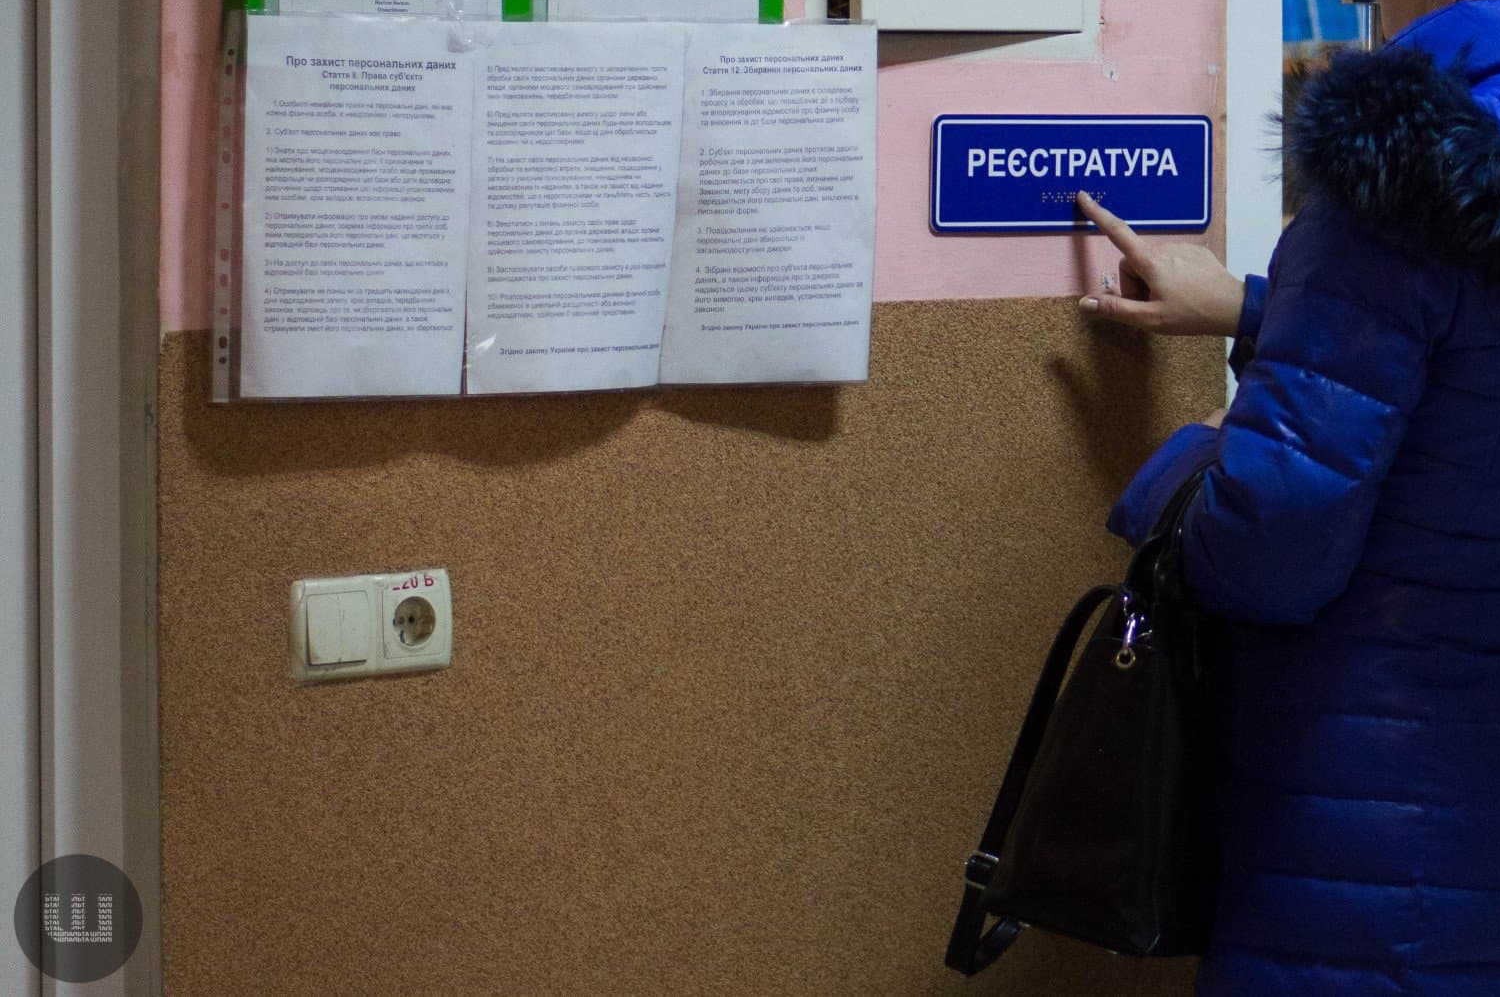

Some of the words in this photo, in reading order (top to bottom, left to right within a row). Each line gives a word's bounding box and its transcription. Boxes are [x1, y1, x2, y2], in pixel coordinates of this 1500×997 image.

[286, 55, 307, 69] Про
[310, 57, 345, 68] захист
[967, 148, 1178, 178] РЕЄСТРАТУРА
